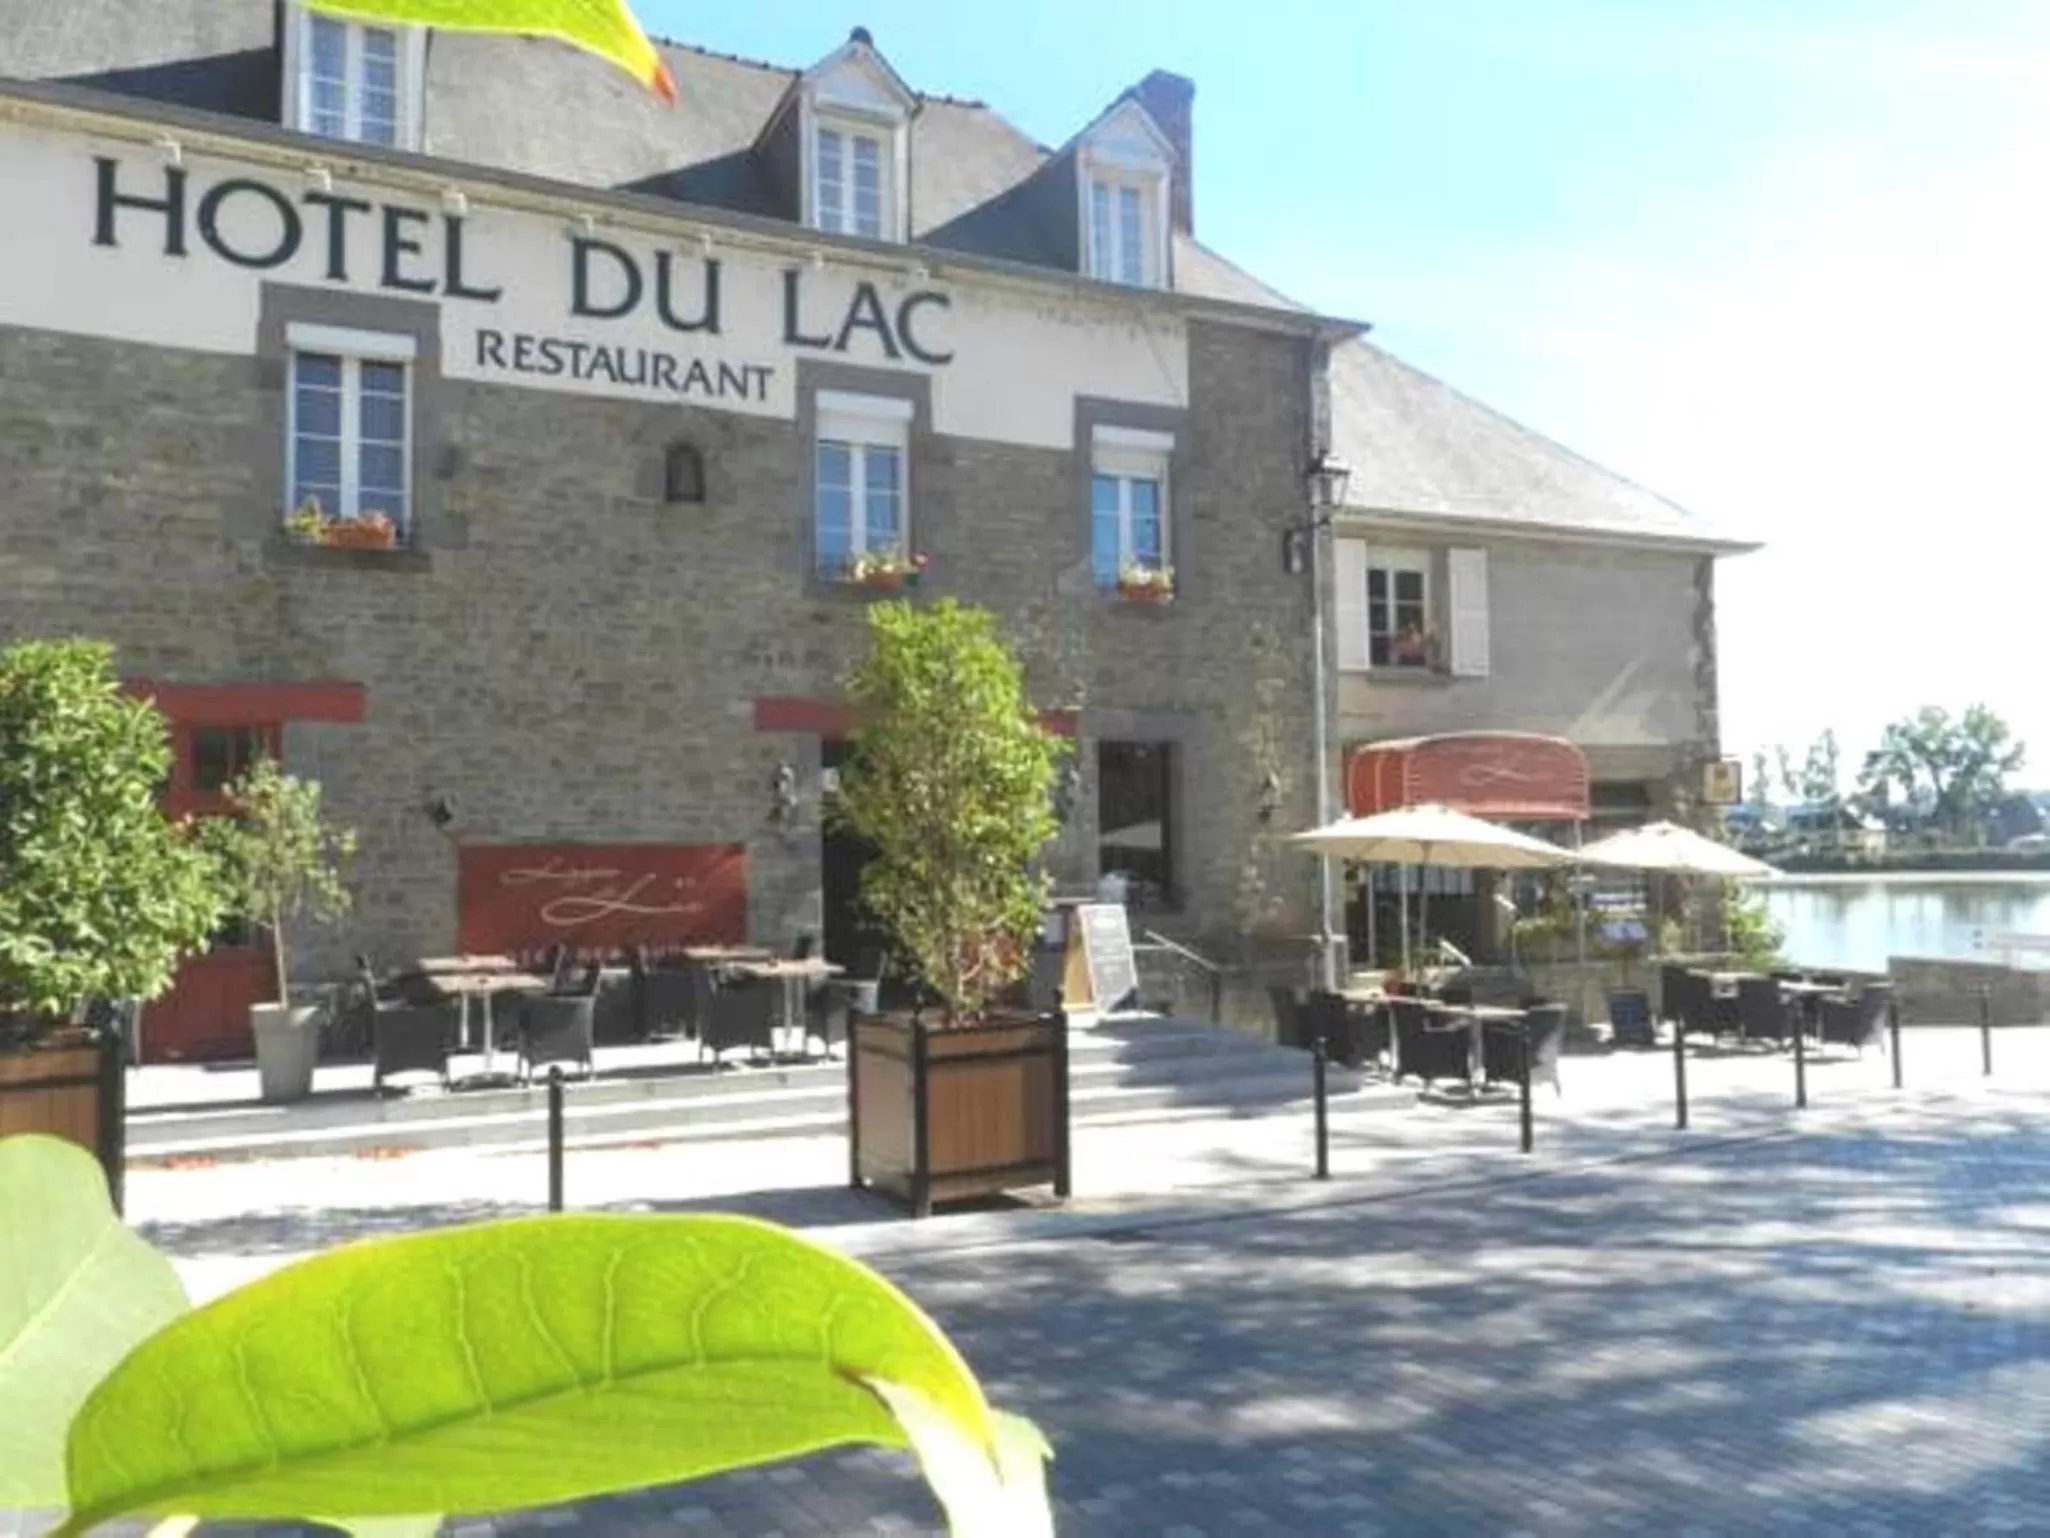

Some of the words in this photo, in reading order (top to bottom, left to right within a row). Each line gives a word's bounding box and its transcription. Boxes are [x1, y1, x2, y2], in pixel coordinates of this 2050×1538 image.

[92, 156, 503, 303] HOTEL
[570, 236, 722, 334] DU
[783, 267, 954, 364] LAC
[475, 328, 776, 402] RESTAURANT
